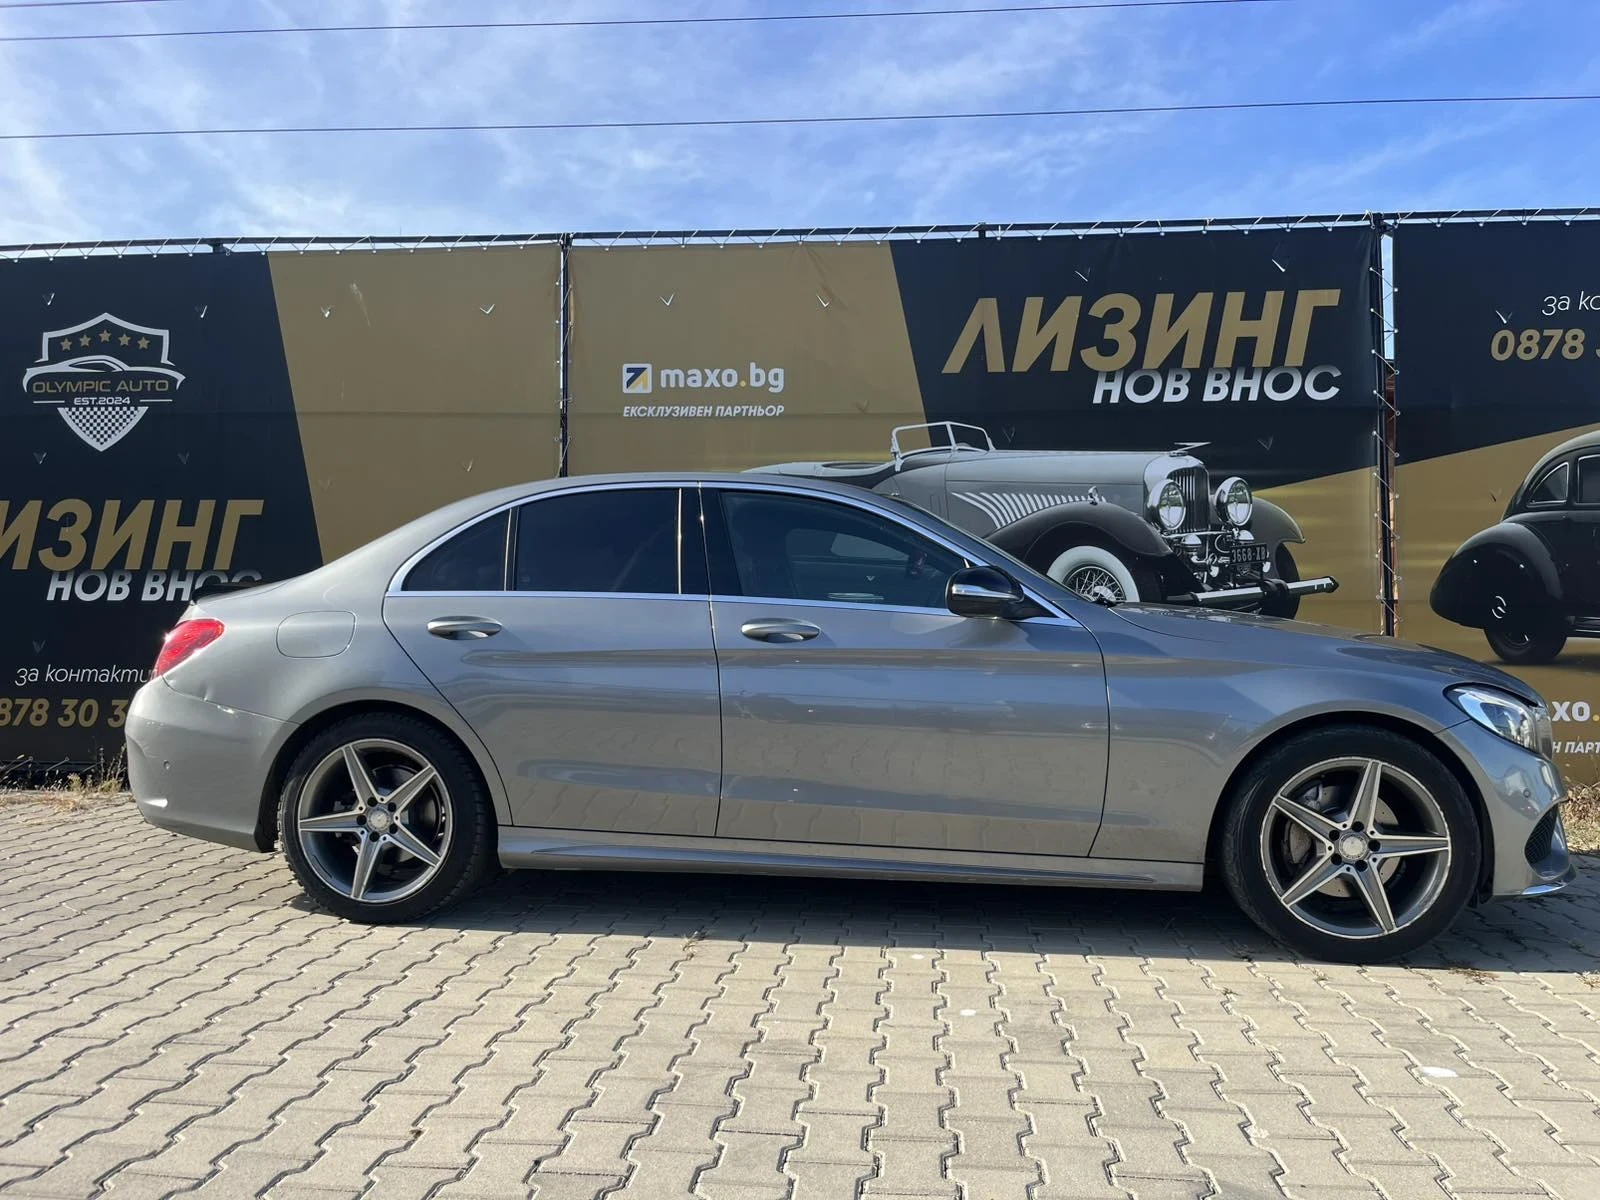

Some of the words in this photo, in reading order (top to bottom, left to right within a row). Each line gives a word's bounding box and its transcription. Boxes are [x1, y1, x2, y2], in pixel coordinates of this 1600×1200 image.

[942, 289, 1341, 373] ЛИЗИНГ
[1490, 329, 1585, 361] 0878
[33, 381, 111, 393] OLYMPIC
[116, 379, 169, 392] AUTO
[660, 362, 785, 393] maxo.bg
[1092, 368, 1192, 404] НОВ
[1202, 365, 1342, 402] ВНОС
[74, 397, 131, 405] EST.2024
[623, 406, 713, 418] ЕКСКЛУЗИВЕН
[715, 405, 785, 417] ПАРТНЬОР
[46, 569, 132, 601] НОВ
[15, 668, 39, 686] за
[0, 698, 50, 727] 878
[57, 698, 99, 728] 30
